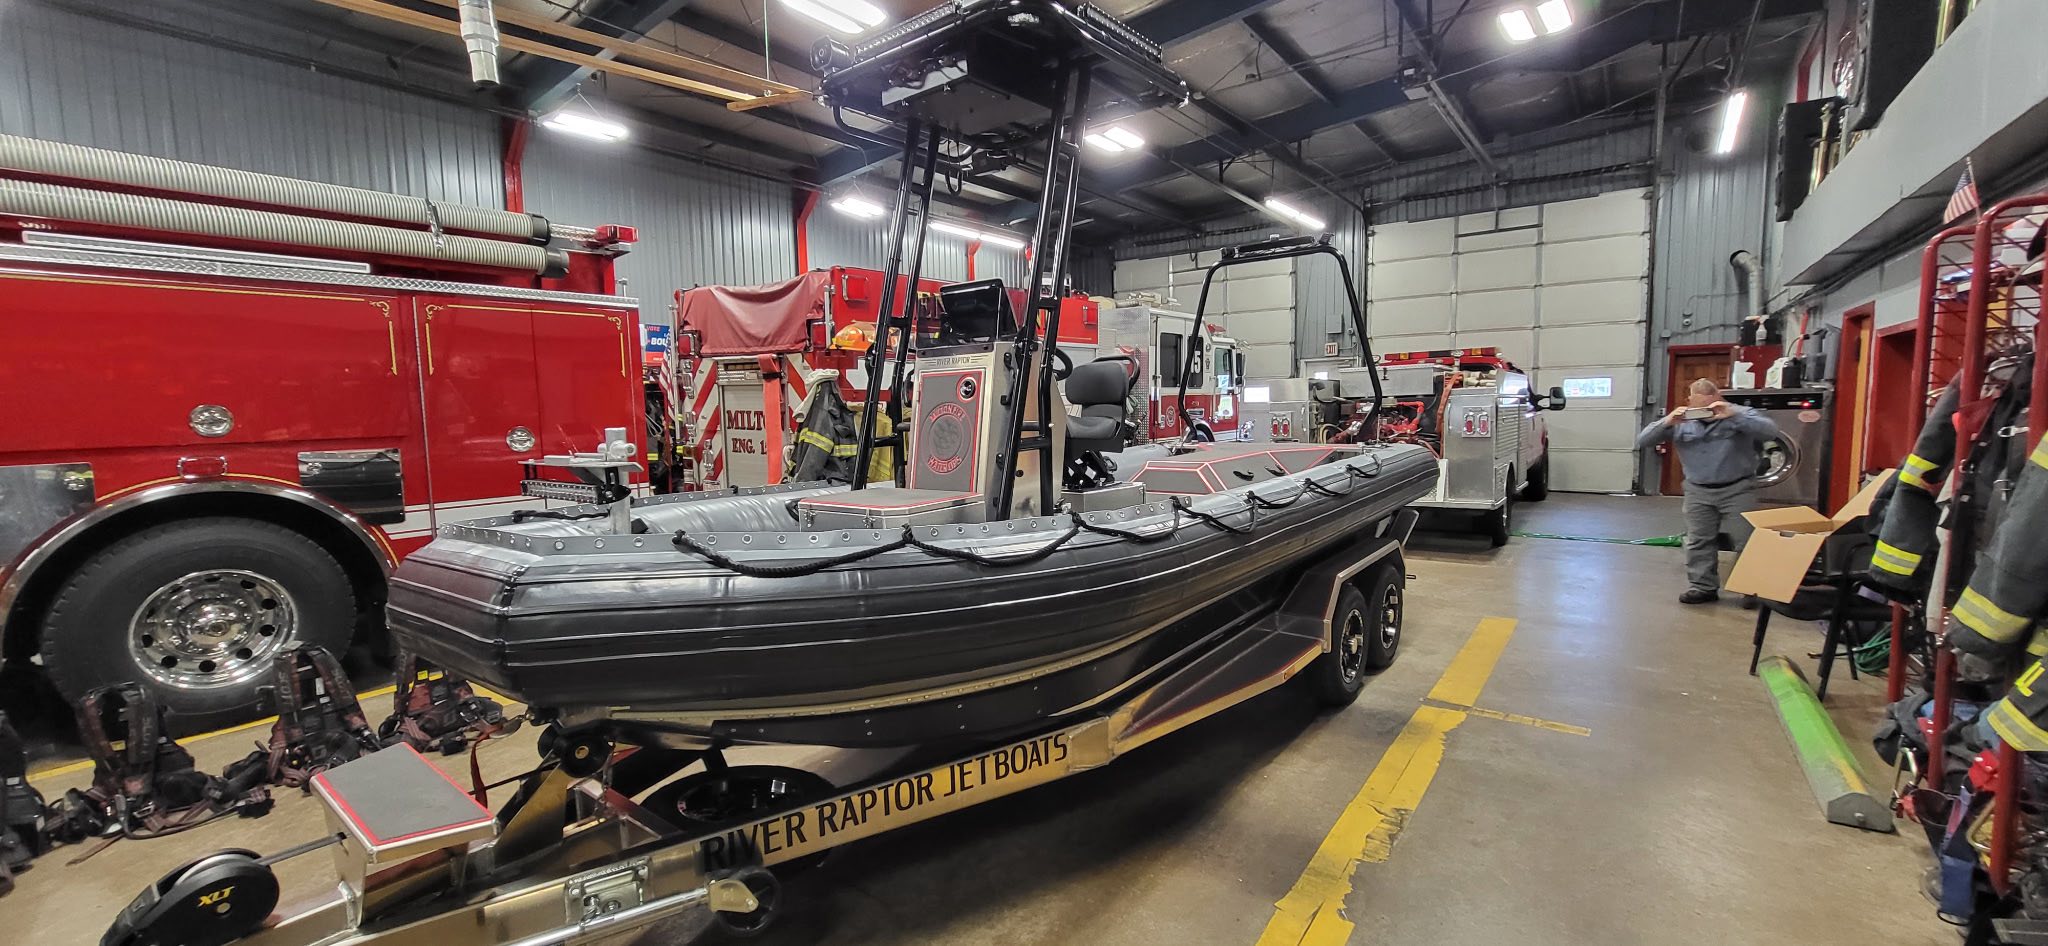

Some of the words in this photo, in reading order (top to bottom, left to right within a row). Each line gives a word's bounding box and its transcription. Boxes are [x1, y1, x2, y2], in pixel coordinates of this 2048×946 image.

[726, 410, 785, 431] MILT
[731, 438, 756, 455] ENG.
[700, 810, 808, 873] RIVER
[815, 772, 935, 837] RAPTOR
[943, 733, 1068, 798] JETBOATS
[198, 886, 235, 907] XLT
